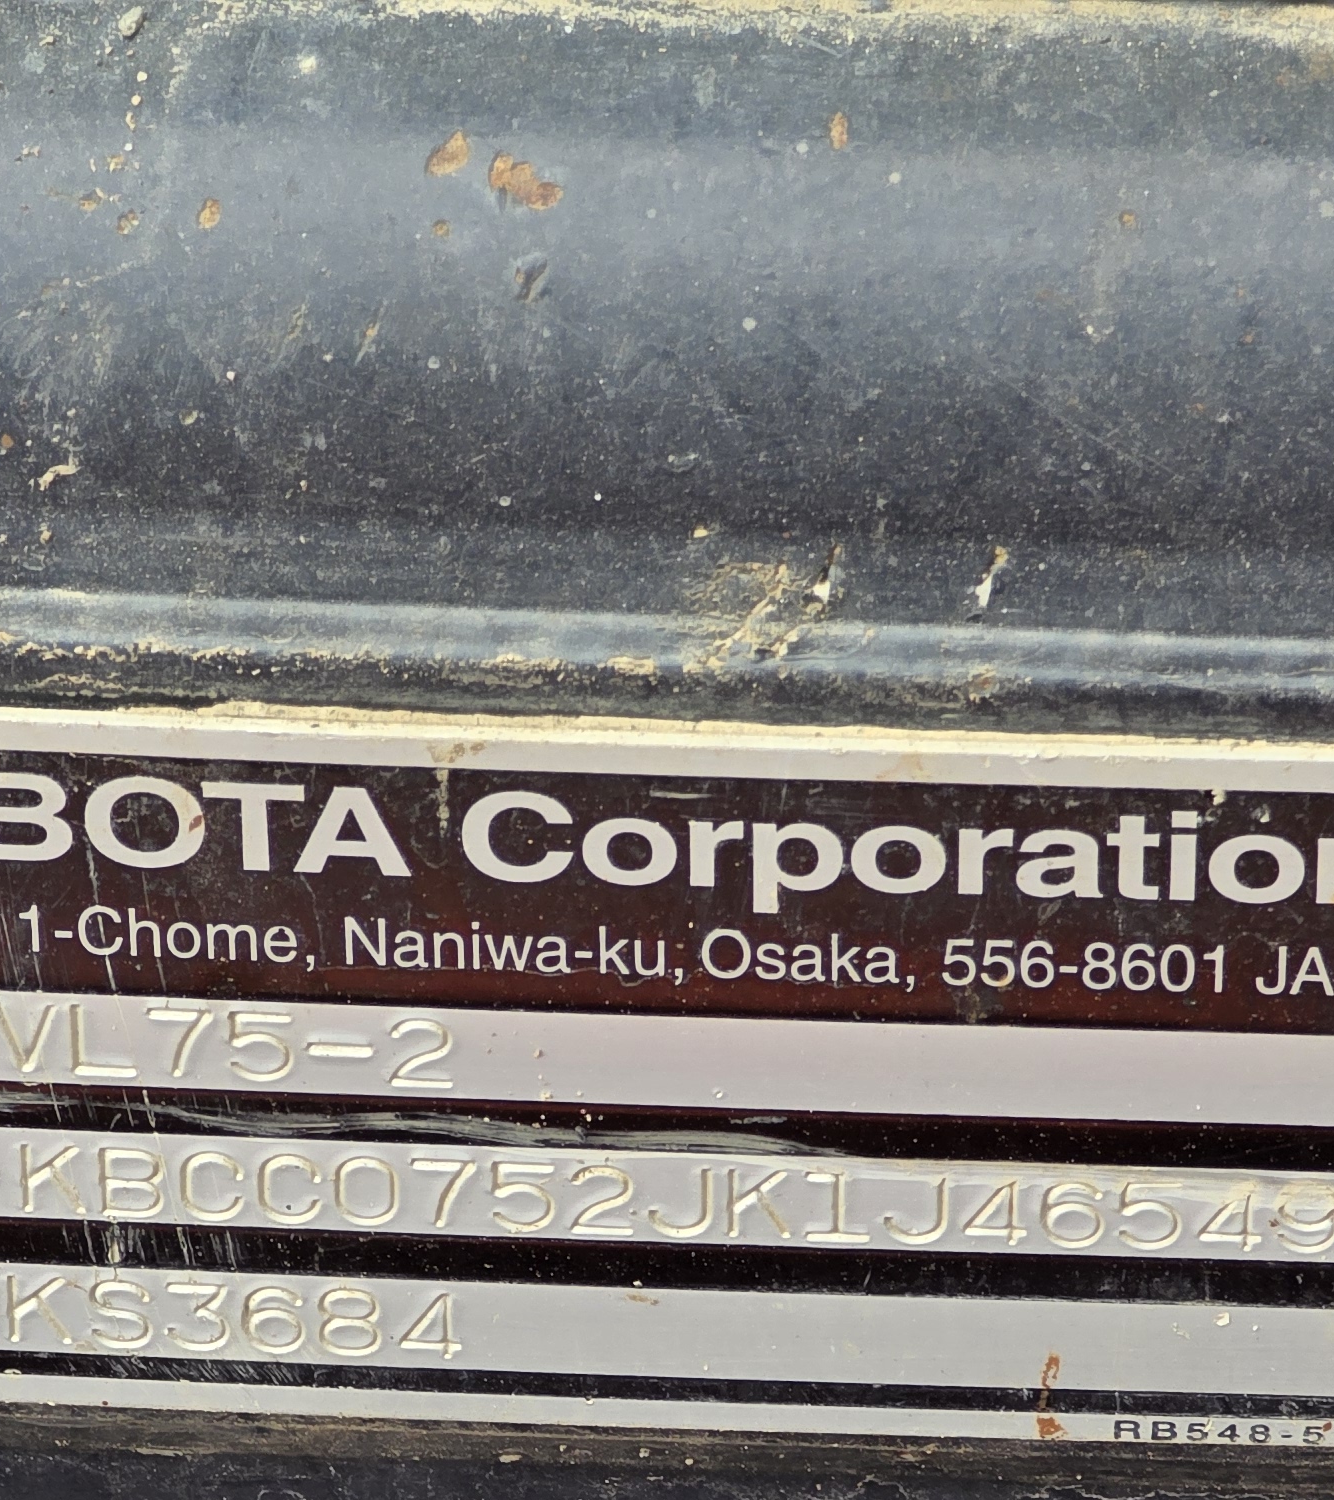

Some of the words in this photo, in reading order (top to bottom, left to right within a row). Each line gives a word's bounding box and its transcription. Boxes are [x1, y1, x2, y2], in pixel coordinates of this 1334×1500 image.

[18, 903, 317, 973] 1-Chome,
[344, 915, 686, 987] Naniwa-ku,
[700, 927, 917, 993] Osaka,
[940, 938, 1227, 995] 556-8601
